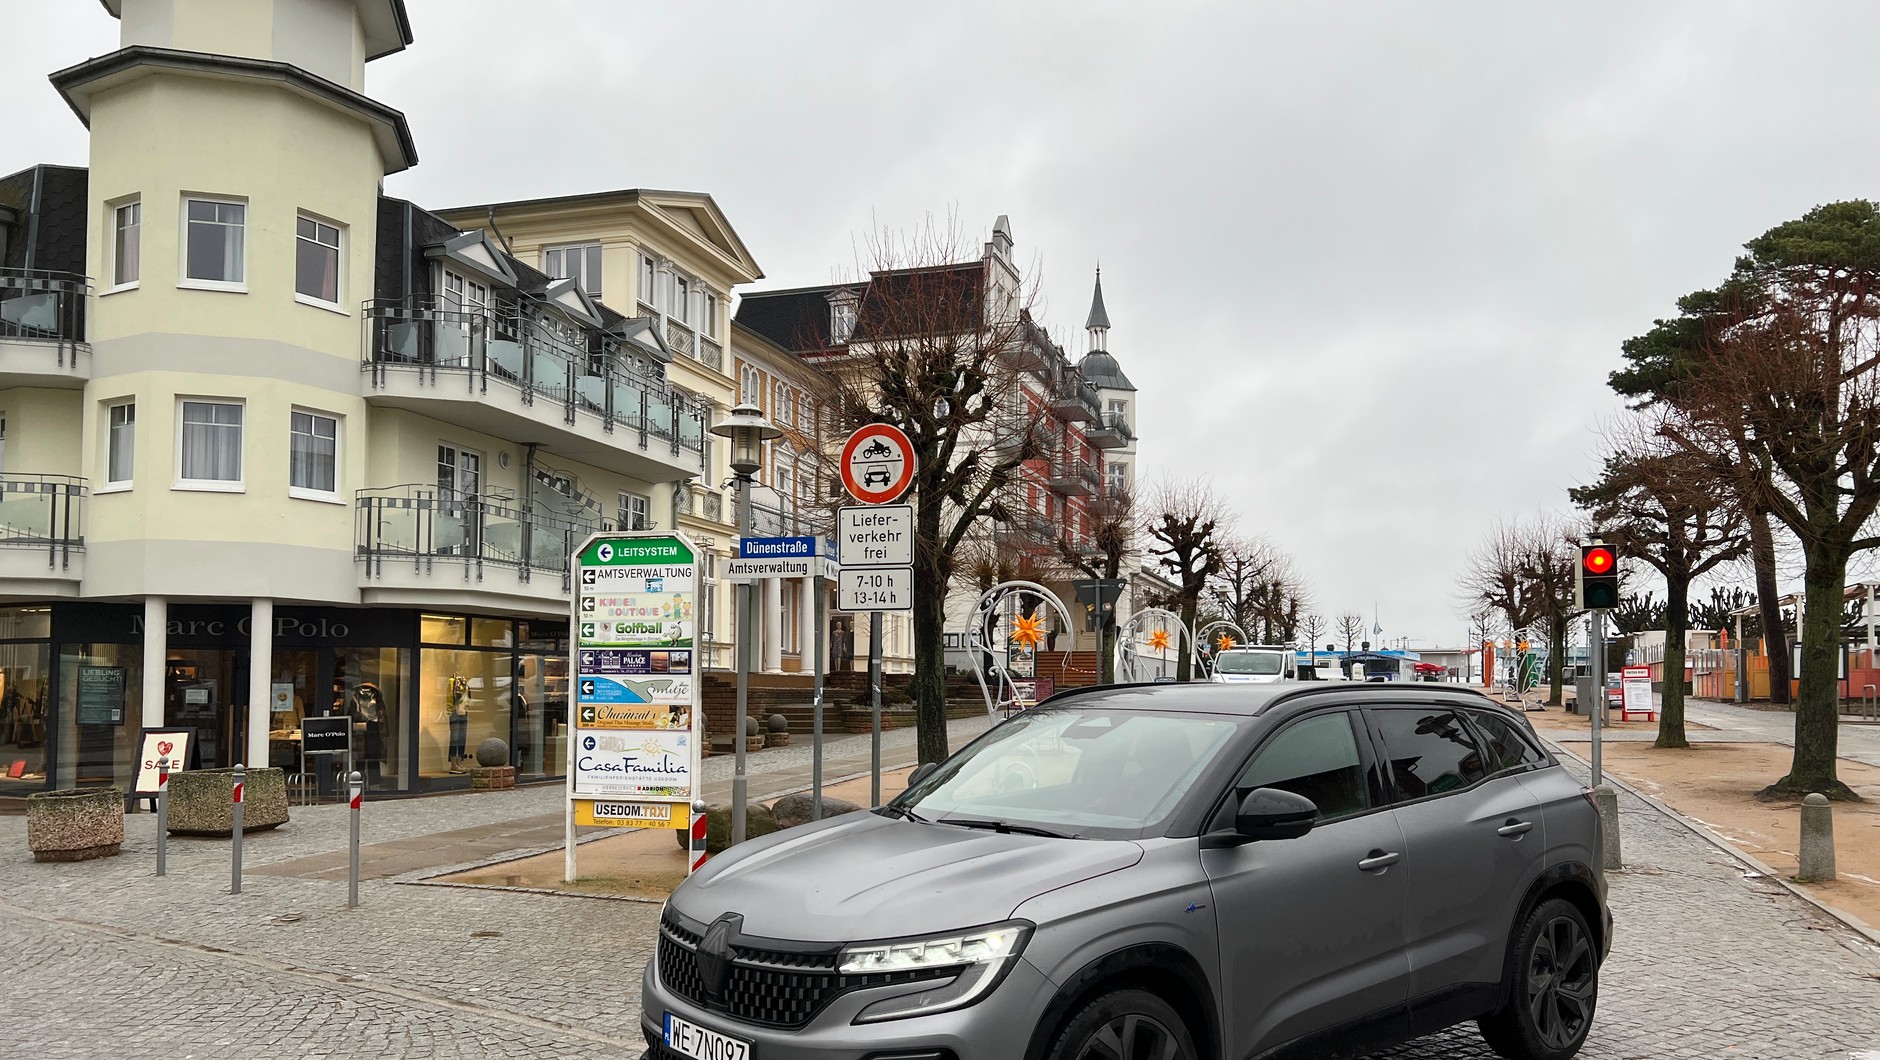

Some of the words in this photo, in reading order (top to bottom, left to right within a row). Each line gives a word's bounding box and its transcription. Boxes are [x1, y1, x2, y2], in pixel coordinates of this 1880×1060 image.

[852, 513, 898, 527] Liefer-
[849, 529, 902, 543] verkehr
[618, 546, 677, 557] LEITSYSTEM
[746, 540, 808, 554] Dünenstraße
[864, 546, 887, 559] frei
[597, 567, 692, 579] AMTSVERWALTUNG
[728, 560, 808, 575] Amtsverwaltung
[856, 575, 883, 588] 7-10
[887, 574, 893, 587] h
[599, 598, 637, 607] KINDER
[854, 591, 887, 604] 13-14
[889, 591, 897, 604] h
[608, 607, 660, 617] BOUTIQUE
[615, 622, 662, 634] Golfball
[144, 760, 181, 770] SAE
[596, 804, 668, 818] USEDOM.TAXI
[664, 1032, 670, 1041] PL
[672, 1019, 690, 1052] WE
